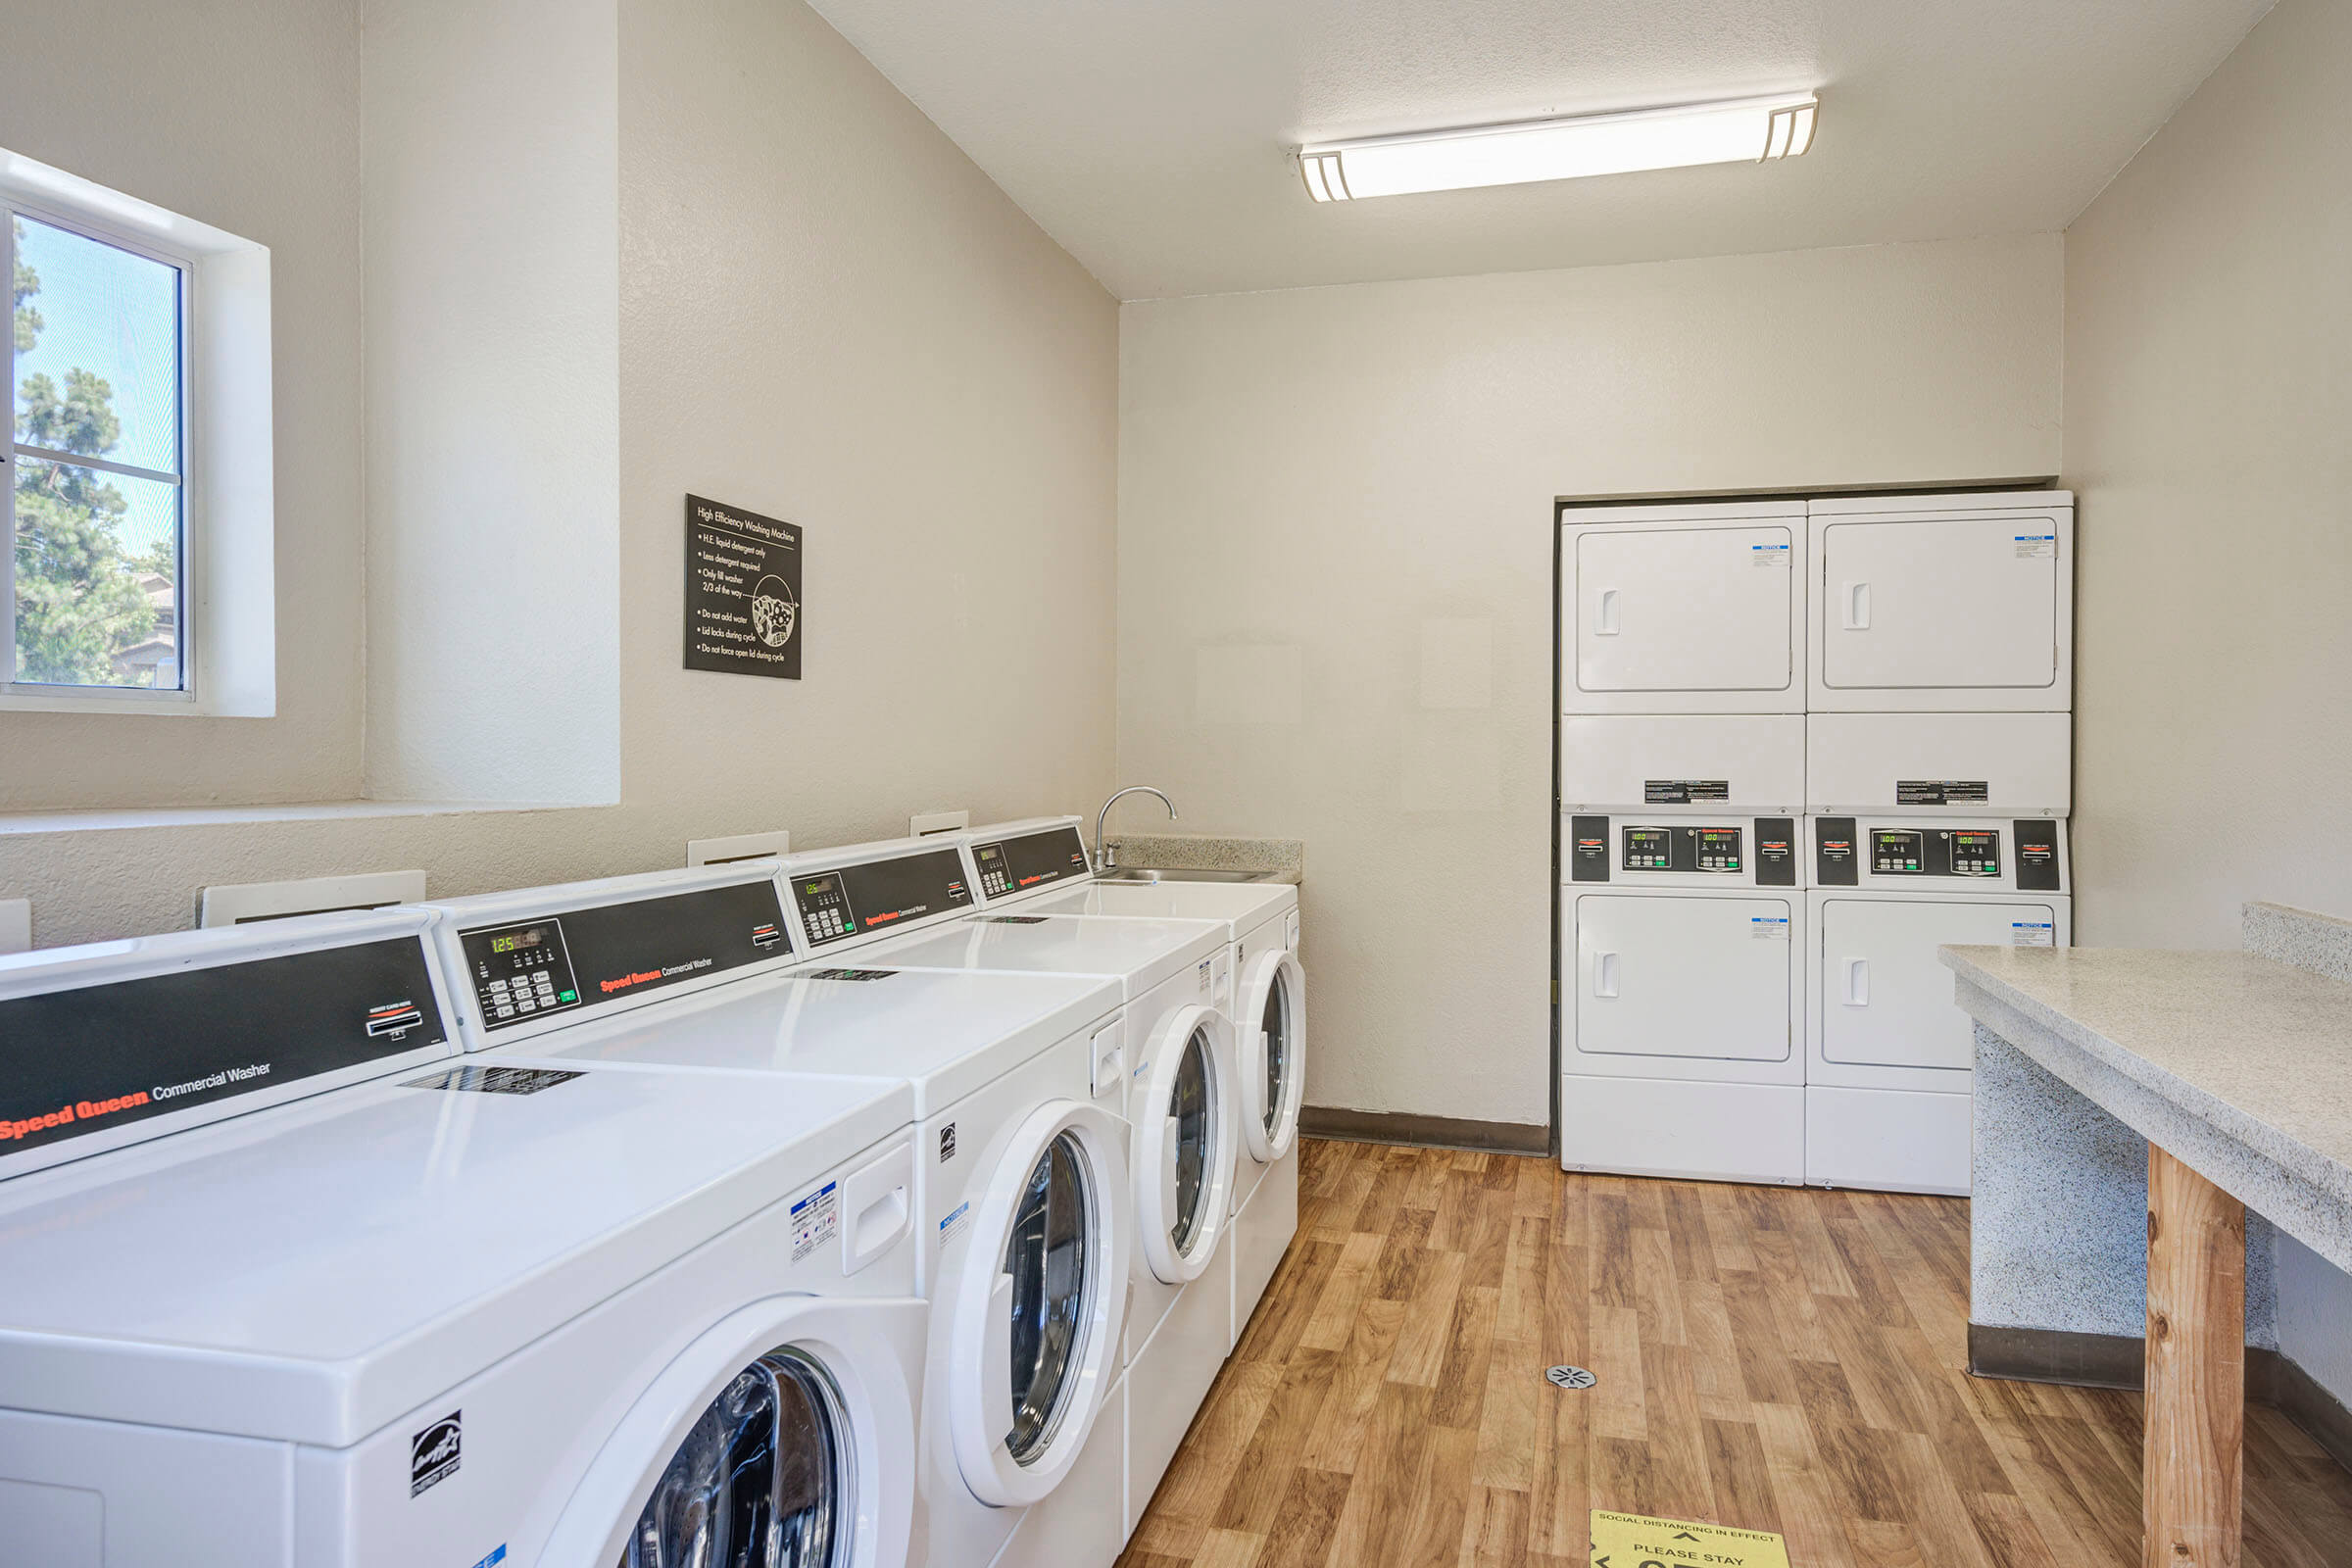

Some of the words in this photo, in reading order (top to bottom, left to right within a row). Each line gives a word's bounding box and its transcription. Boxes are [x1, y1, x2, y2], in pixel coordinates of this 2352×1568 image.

[698, 506, 713, 522] High
[714, 511, 744, 531] Efficiency
[745, 519, 770, 538] Washing
[771, 527, 795, 543] Machine
[703, 533, 715, 545] H.E.
[716, 536, 731, 549] liquid
[731, 541, 755, 556] detergent
[755, 547, 766, 559] only
[703, 551, 714, 562] Less
[715, 553, 739, 567] detergent
[740, 562, 760, 572] required
[703, 568, 716, 580] Only
[725, 574, 743, 584] washer
[703, 582, 714, 593] 2/3
[714, 584, 721, 593] of
[721, 585, 730, 595] the
[731, 589, 742, 600] way
[702, 609, 710, 618] Do
[721, 612, 732, 621] add
[702, 626, 710, 635] Lid
[711, 627, 724, 637] locks
[725, 629, 742, 642] during
[743, 633, 757, 643] cycle
[702, 643, 710, 653] Do
[721, 645, 734, 656] force
[735, 650, 748, 659] open
[757, 651, 771, 662] during
[772, 653, 784, 662] cycle
[600, 974, 632, 993] Speed
[632, 968, 662, 985] Queen
[662, 960, 693, 977] Commercial
[693, 956, 712, 970] Washer
[0, 1105, 74, 1140] Speed
[75, 1090, 150, 1119] Queen
[153, 1071, 226, 1101] Commercial
[226, 1061, 271, 1083] Washer
[1598, 1513, 1639, 1524] SOCIAL
[1643, 1519, 1713, 1535] DISTANCING
[1731, 1531, 1776, 1543] EFFECT
[1634, 1544, 1698, 1559] PLEASE
[1703, 1554, 1744, 1566] STAY
